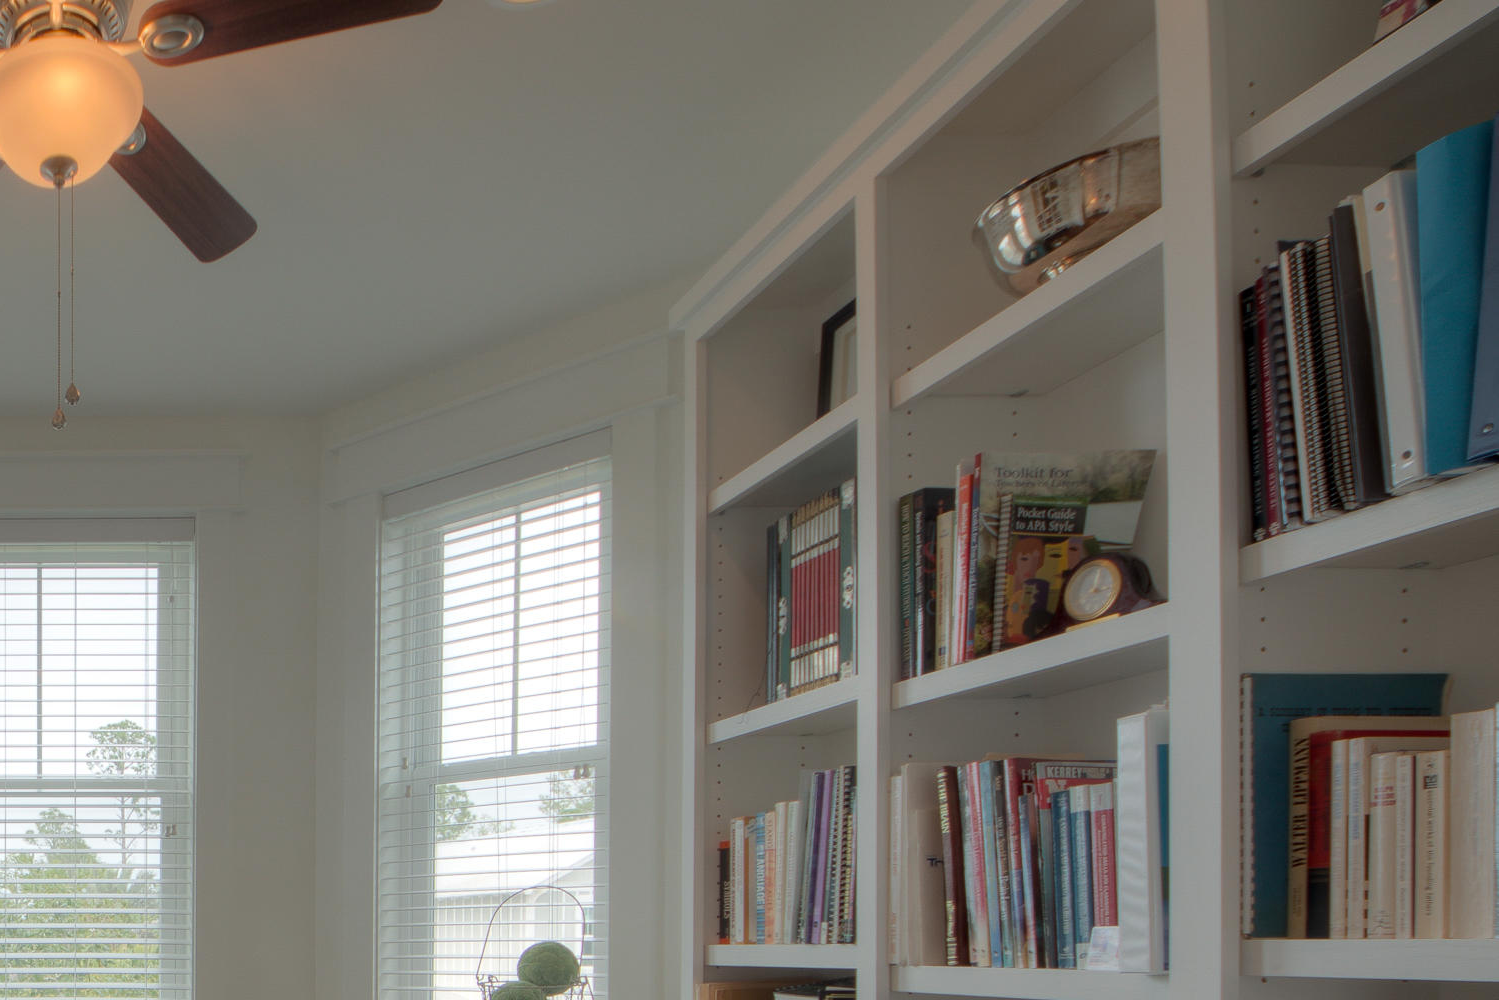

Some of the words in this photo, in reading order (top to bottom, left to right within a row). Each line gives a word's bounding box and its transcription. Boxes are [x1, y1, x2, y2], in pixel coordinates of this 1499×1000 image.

[995, 465, 1046, 480] Toolkit
[1048, 466, 1074, 480] for
[1015, 520, 1026, 531] to
[1027, 519, 1047, 532] APA
[1048, 520, 1076, 535] Style
[1016, 506, 1044, 520] Pocket
[1047, 507, 1077, 521] Guide
[901, 585, 912, 617] STUDENTS
[1045, 766, 1083, 779] KERREY
[1291, 737, 1311, 807] LIPPMANN
[941, 803, 951, 834] BRAIN
[1291, 814, 1310, 869] WALTER
[724, 881, 732, 920] SYMBOLS
